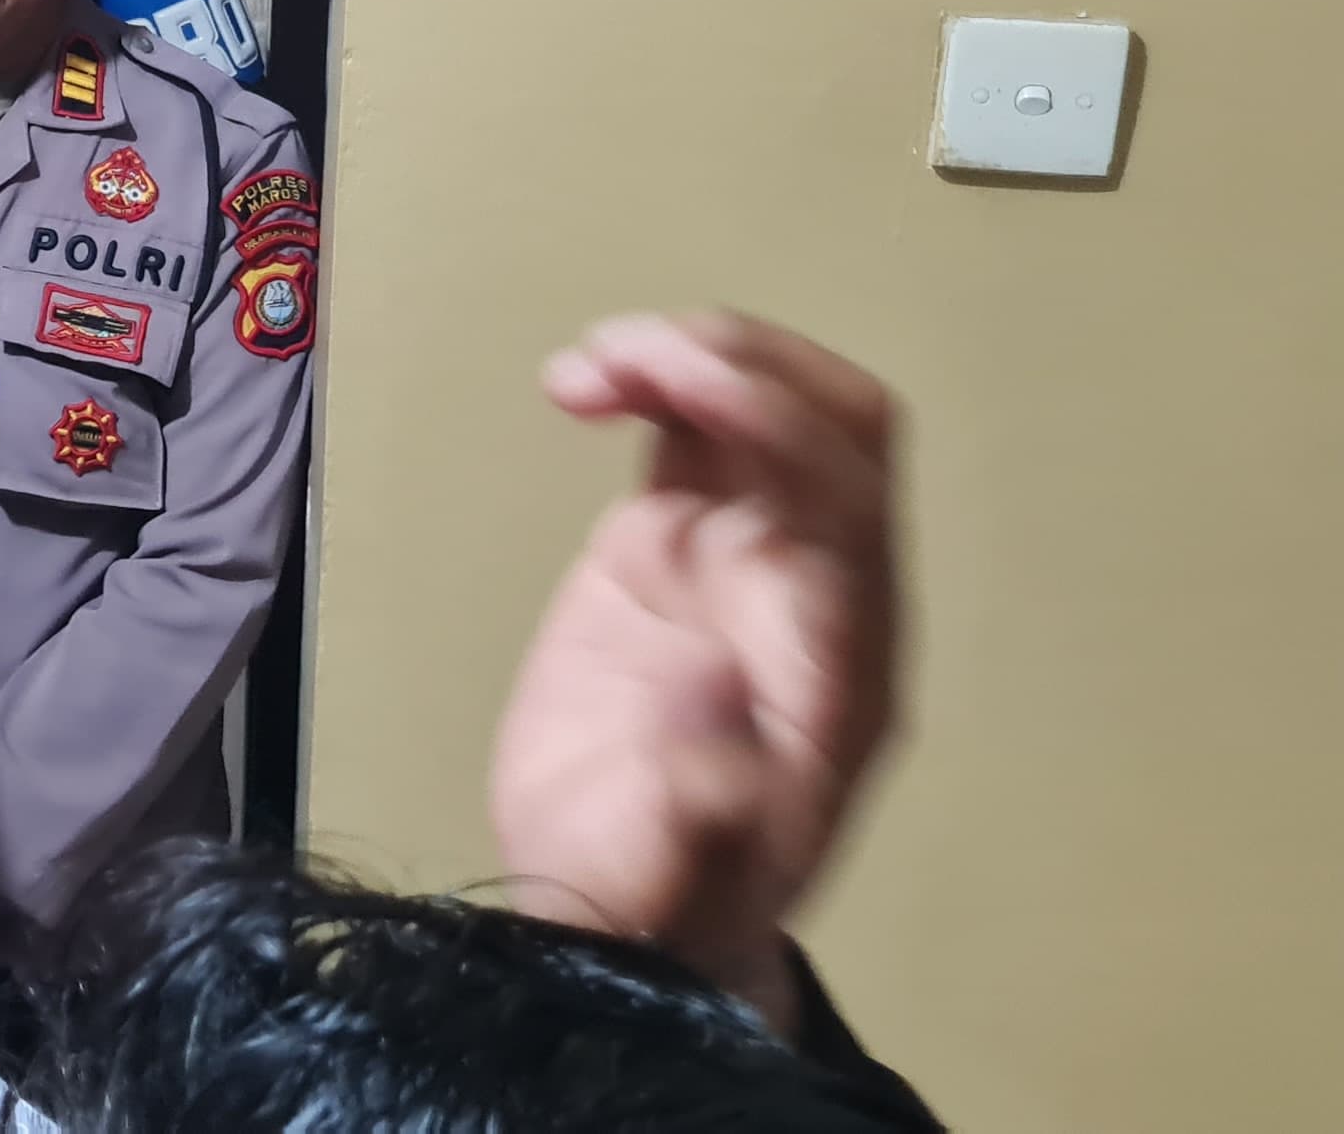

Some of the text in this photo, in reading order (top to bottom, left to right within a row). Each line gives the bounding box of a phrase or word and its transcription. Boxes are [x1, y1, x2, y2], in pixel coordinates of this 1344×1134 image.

[231, 175, 308, 212] POLRES
[247, 188, 301, 214] MAROS
[29, 227, 185, 292] POLRI
